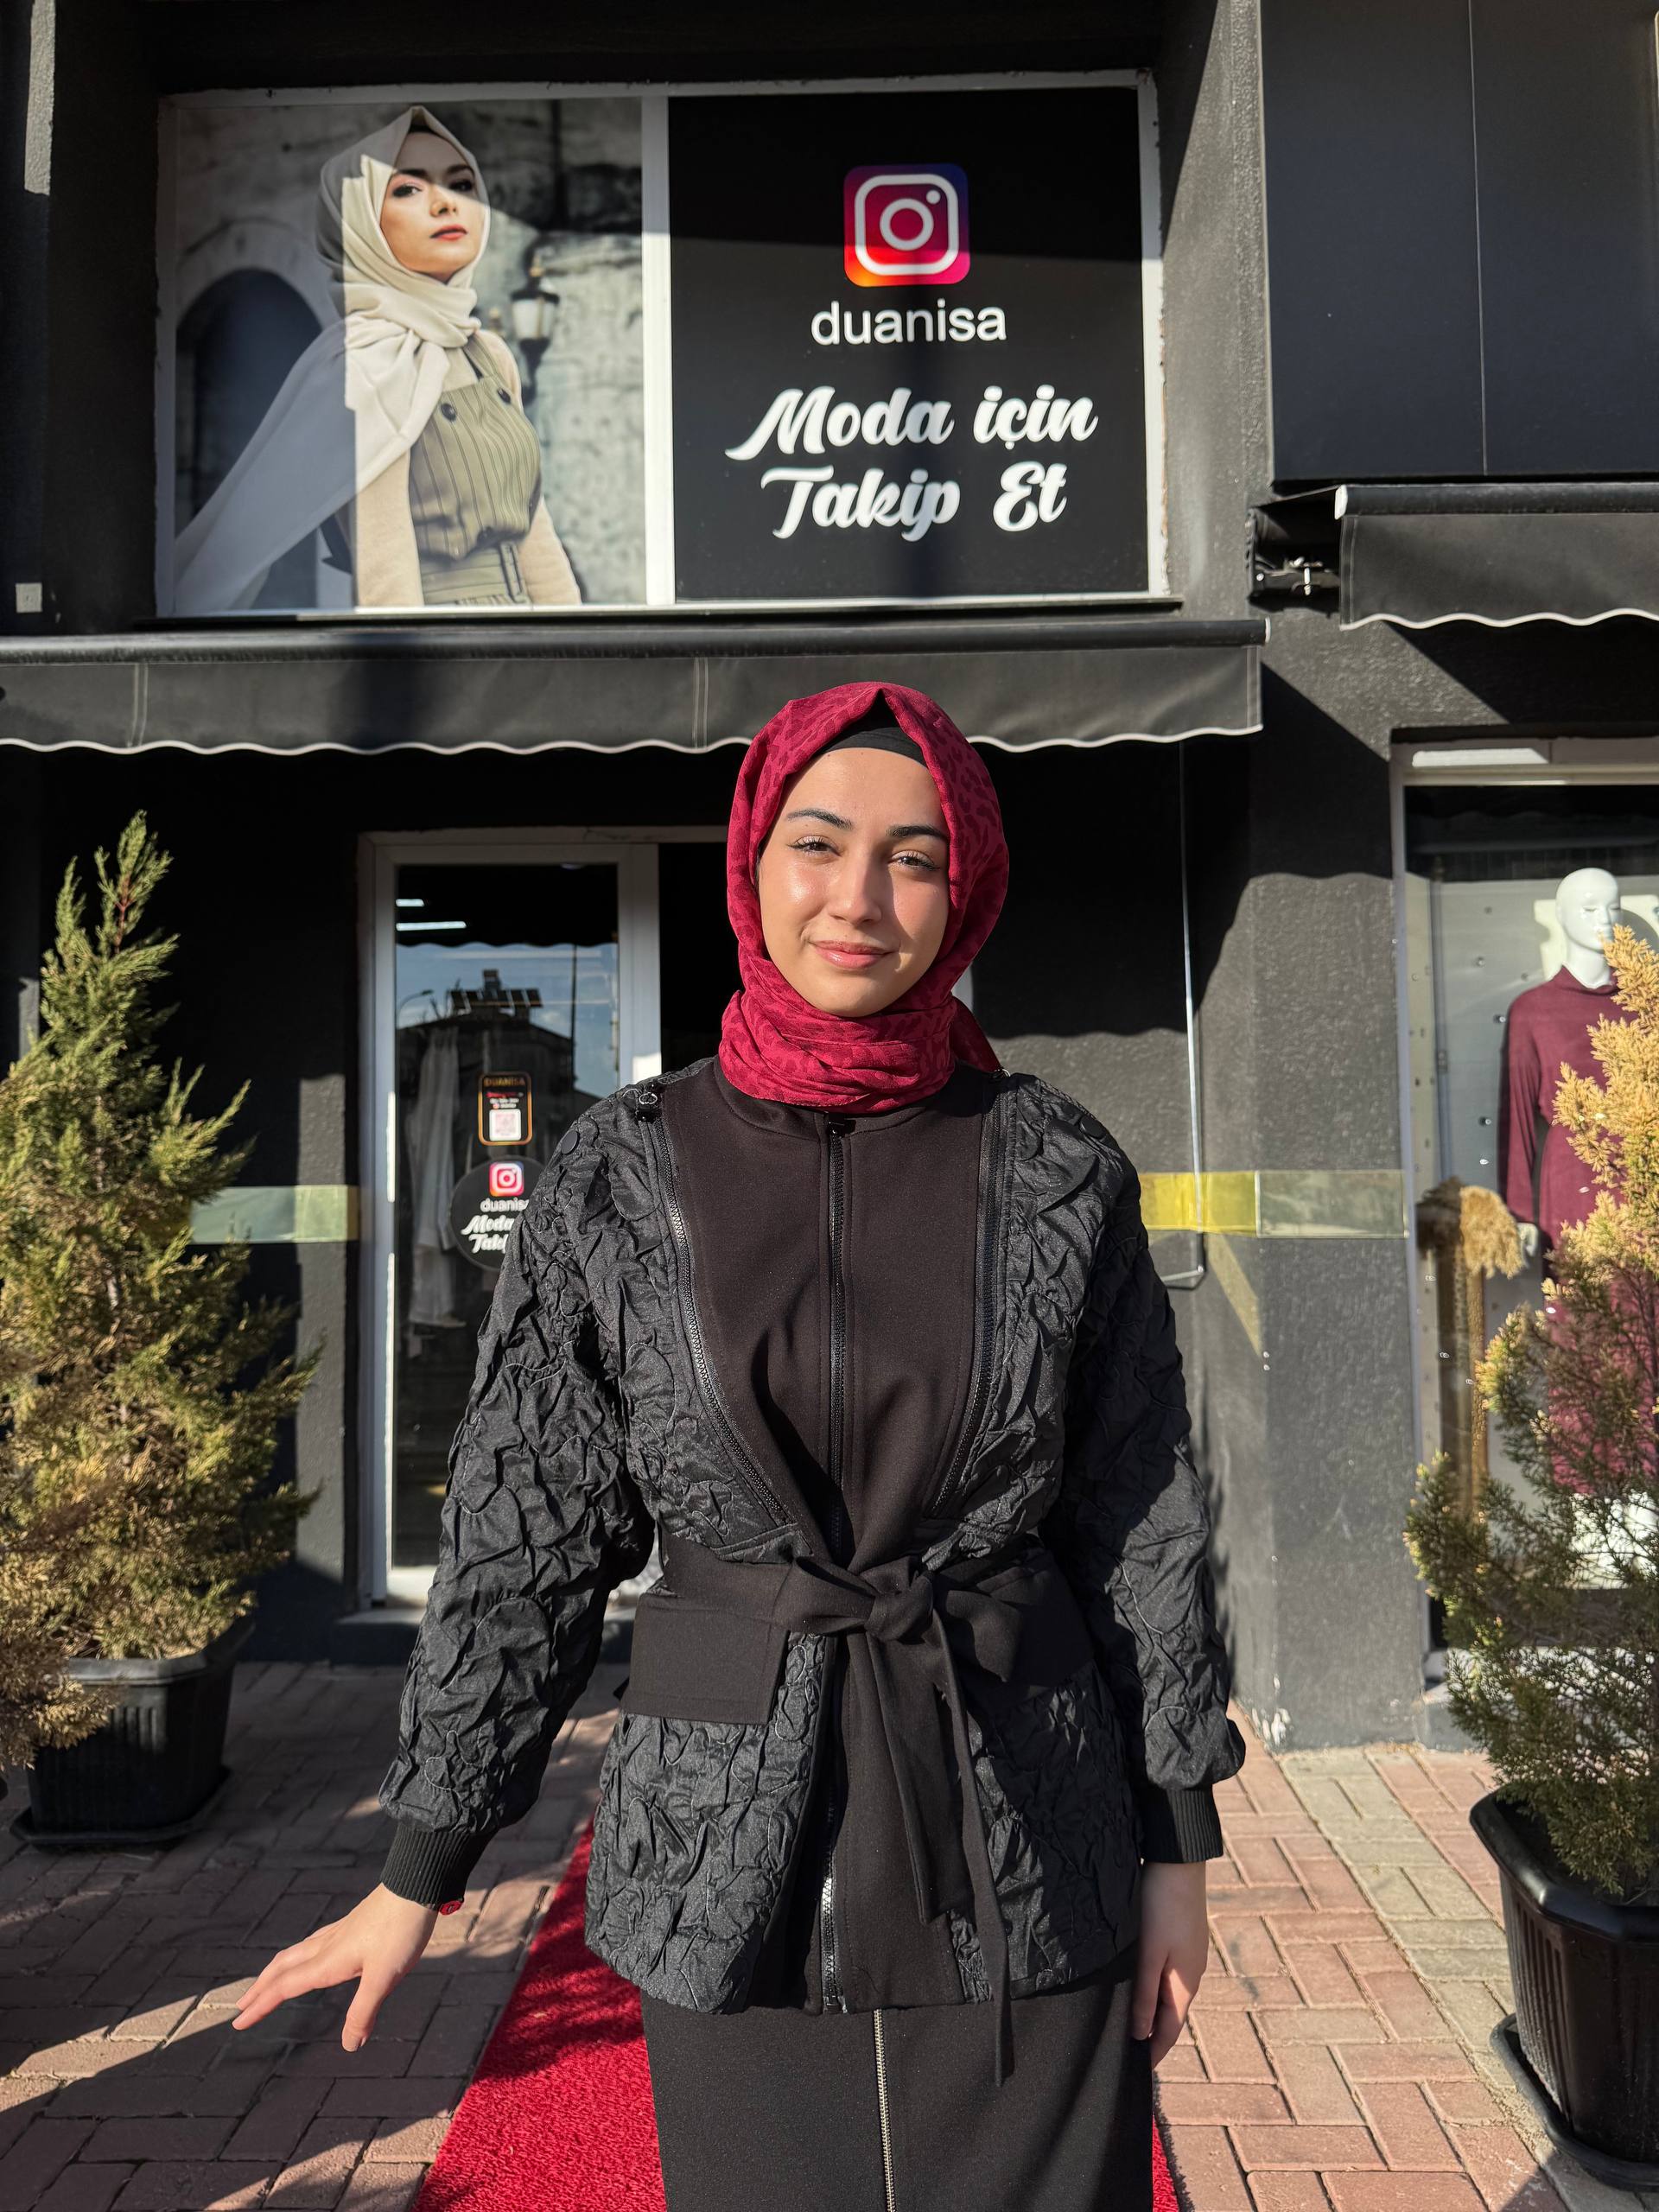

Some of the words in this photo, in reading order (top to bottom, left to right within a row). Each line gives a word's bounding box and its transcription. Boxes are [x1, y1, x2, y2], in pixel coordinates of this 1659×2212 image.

[810, 298, 1007, 346] duanisa
[724, 385, 955, 461] Moda
[973, 385, 1099, 450] için
[761, 465, 961, 542] Takip
[993, 461, 1068, 532] Et
